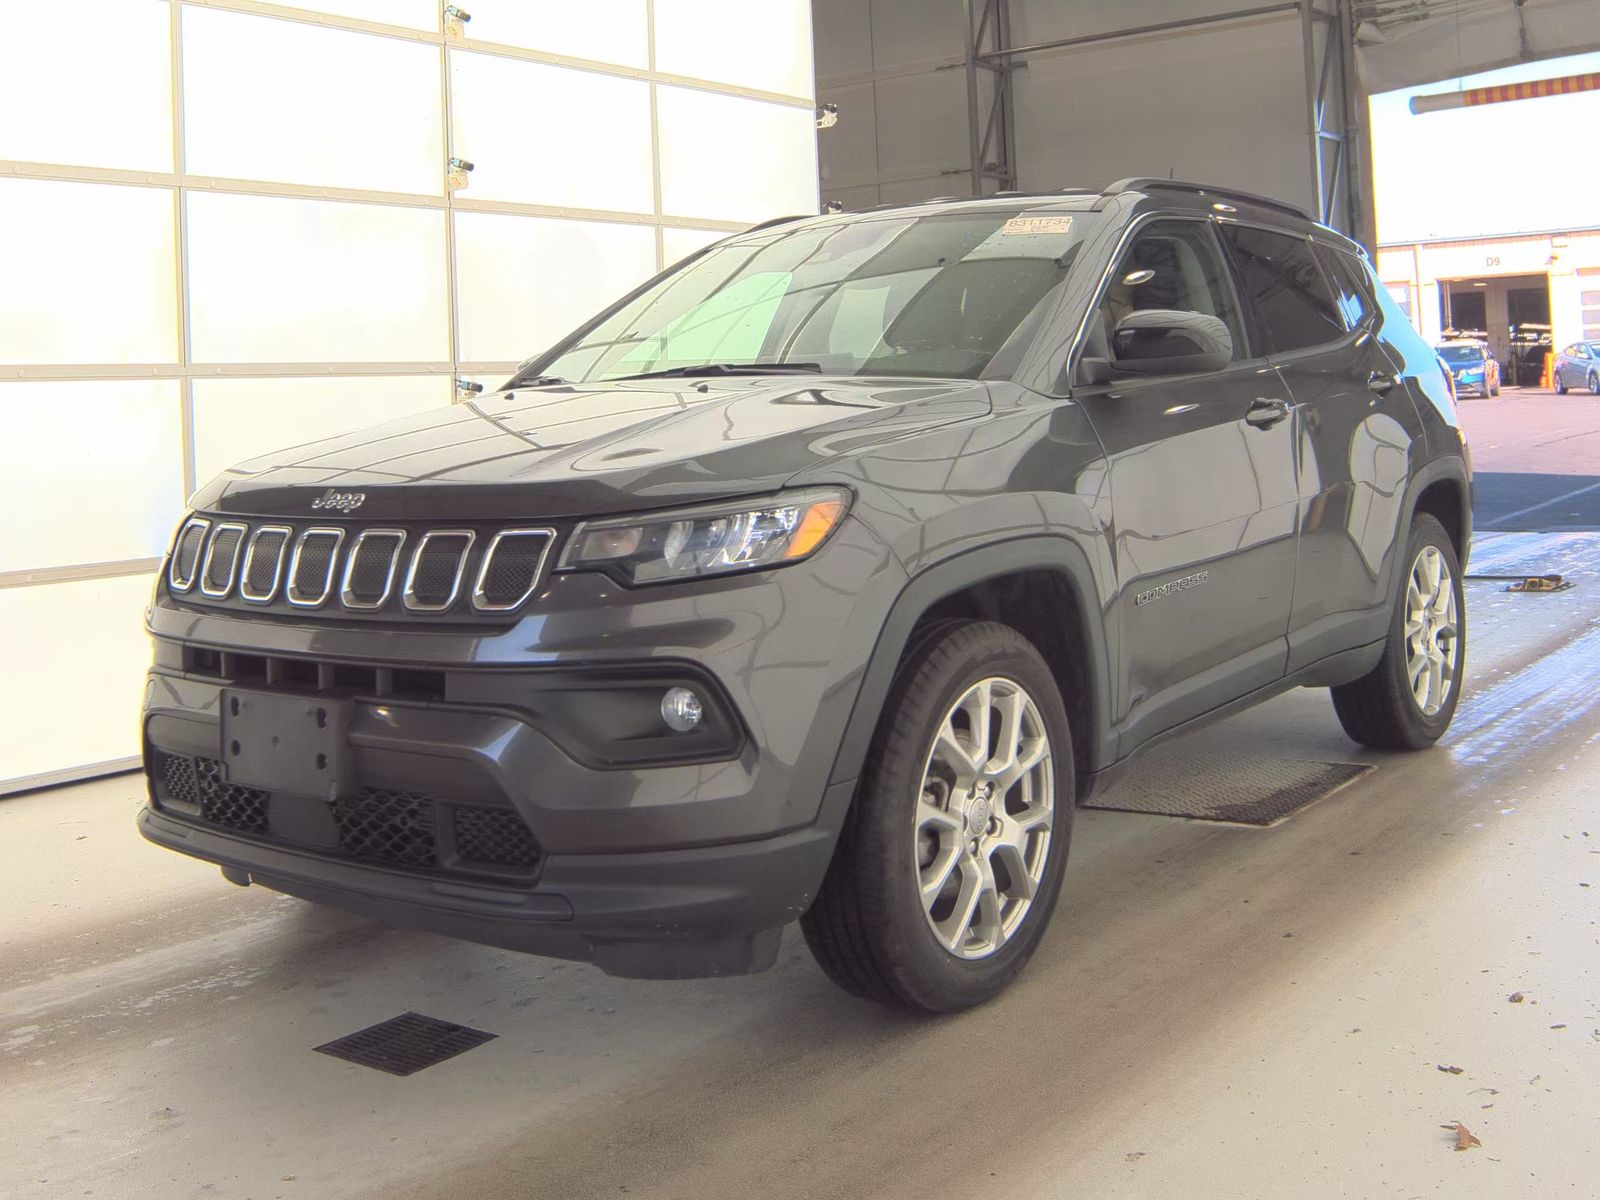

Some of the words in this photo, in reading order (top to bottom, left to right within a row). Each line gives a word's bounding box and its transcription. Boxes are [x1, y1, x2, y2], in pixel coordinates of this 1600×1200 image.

[1008, 217, 1071, 228] 8311734
[1486, 256, 1501, 266] D9
[311, 488, 366, 513] Jeep
[1136, 570, 1208, 606] COMPASS
